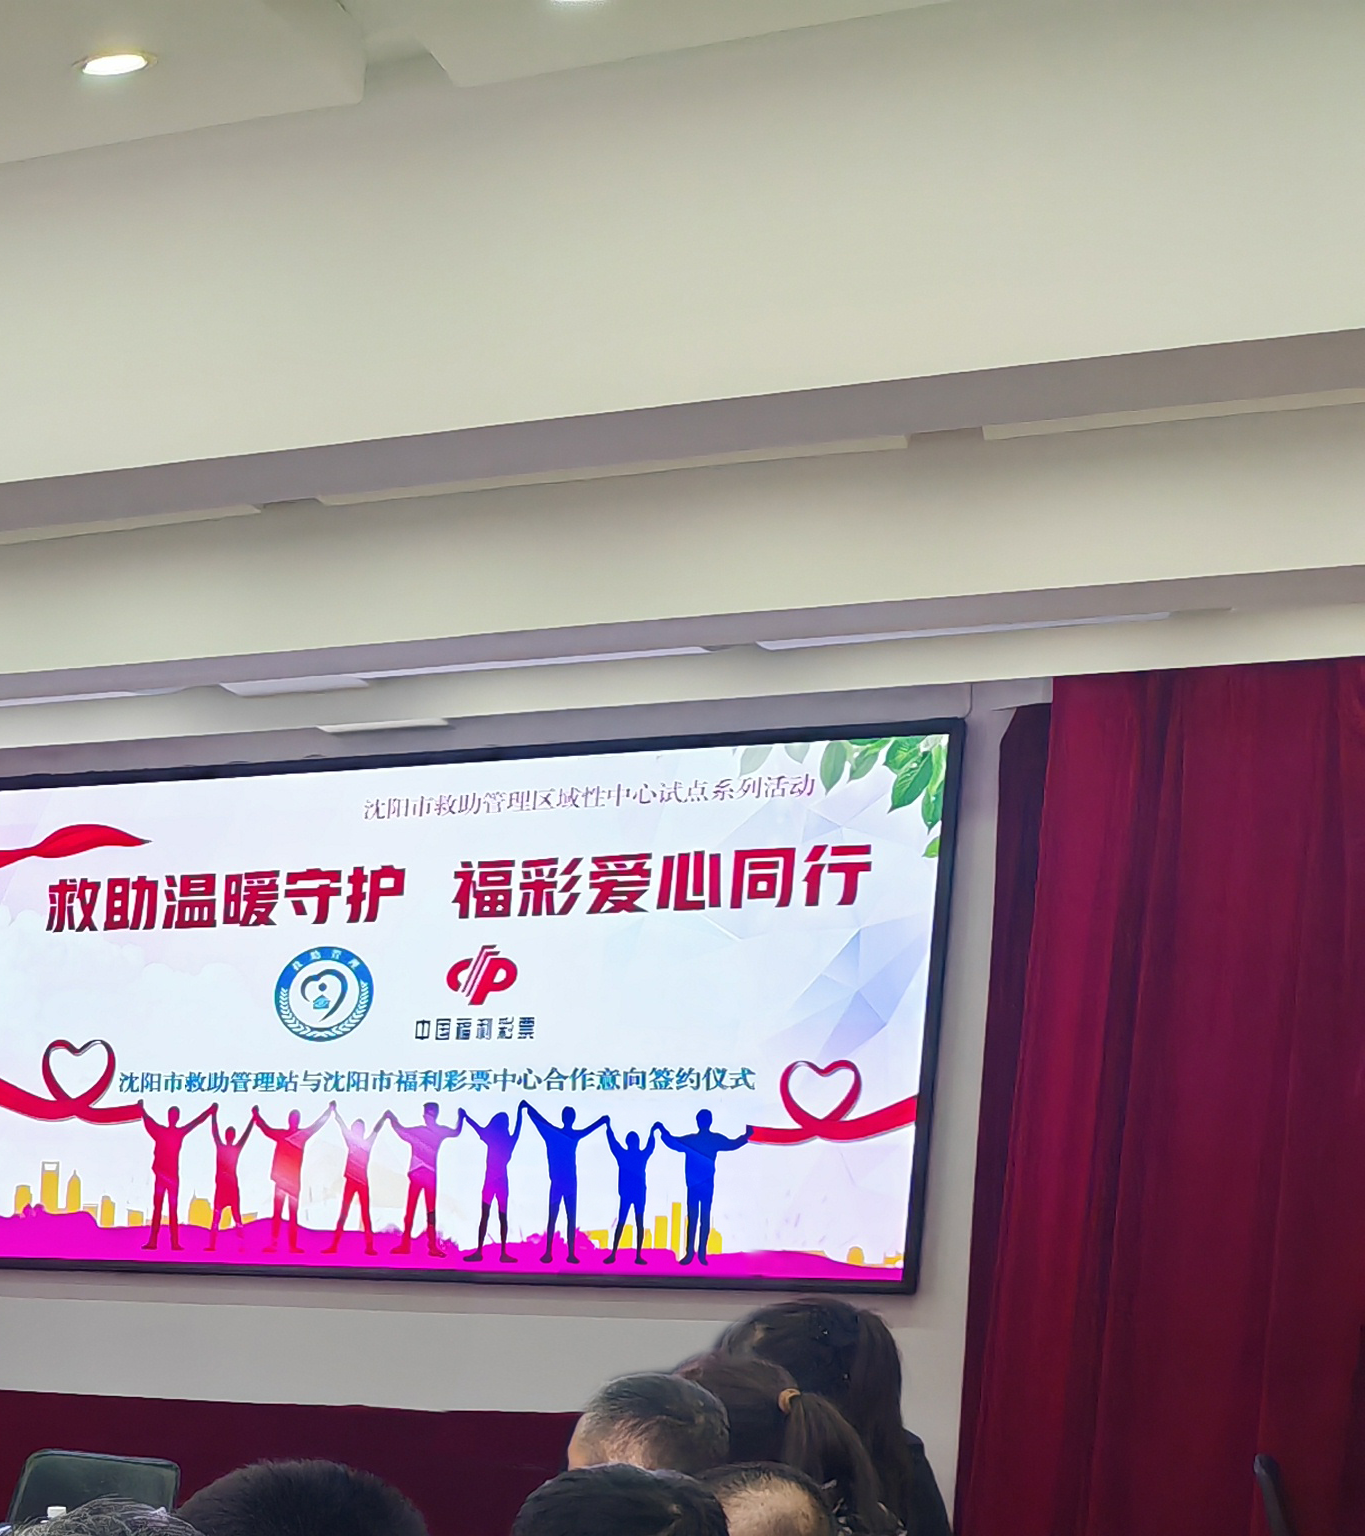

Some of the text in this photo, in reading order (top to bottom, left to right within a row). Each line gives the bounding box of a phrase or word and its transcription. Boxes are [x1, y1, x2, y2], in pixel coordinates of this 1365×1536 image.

[363, 774, 816, 822] 沈阳市救助管理区域性中心试点系列活动
[45, 844, 872, 933] 救助温暖守护 福彩爱心同行
[415, 1017, 535, 1041] 中国福利彩票
[118, 1066, 756, 1096] 沈阳市救助管理站与沈阳市福利彩票中心合作意向签约仪式
